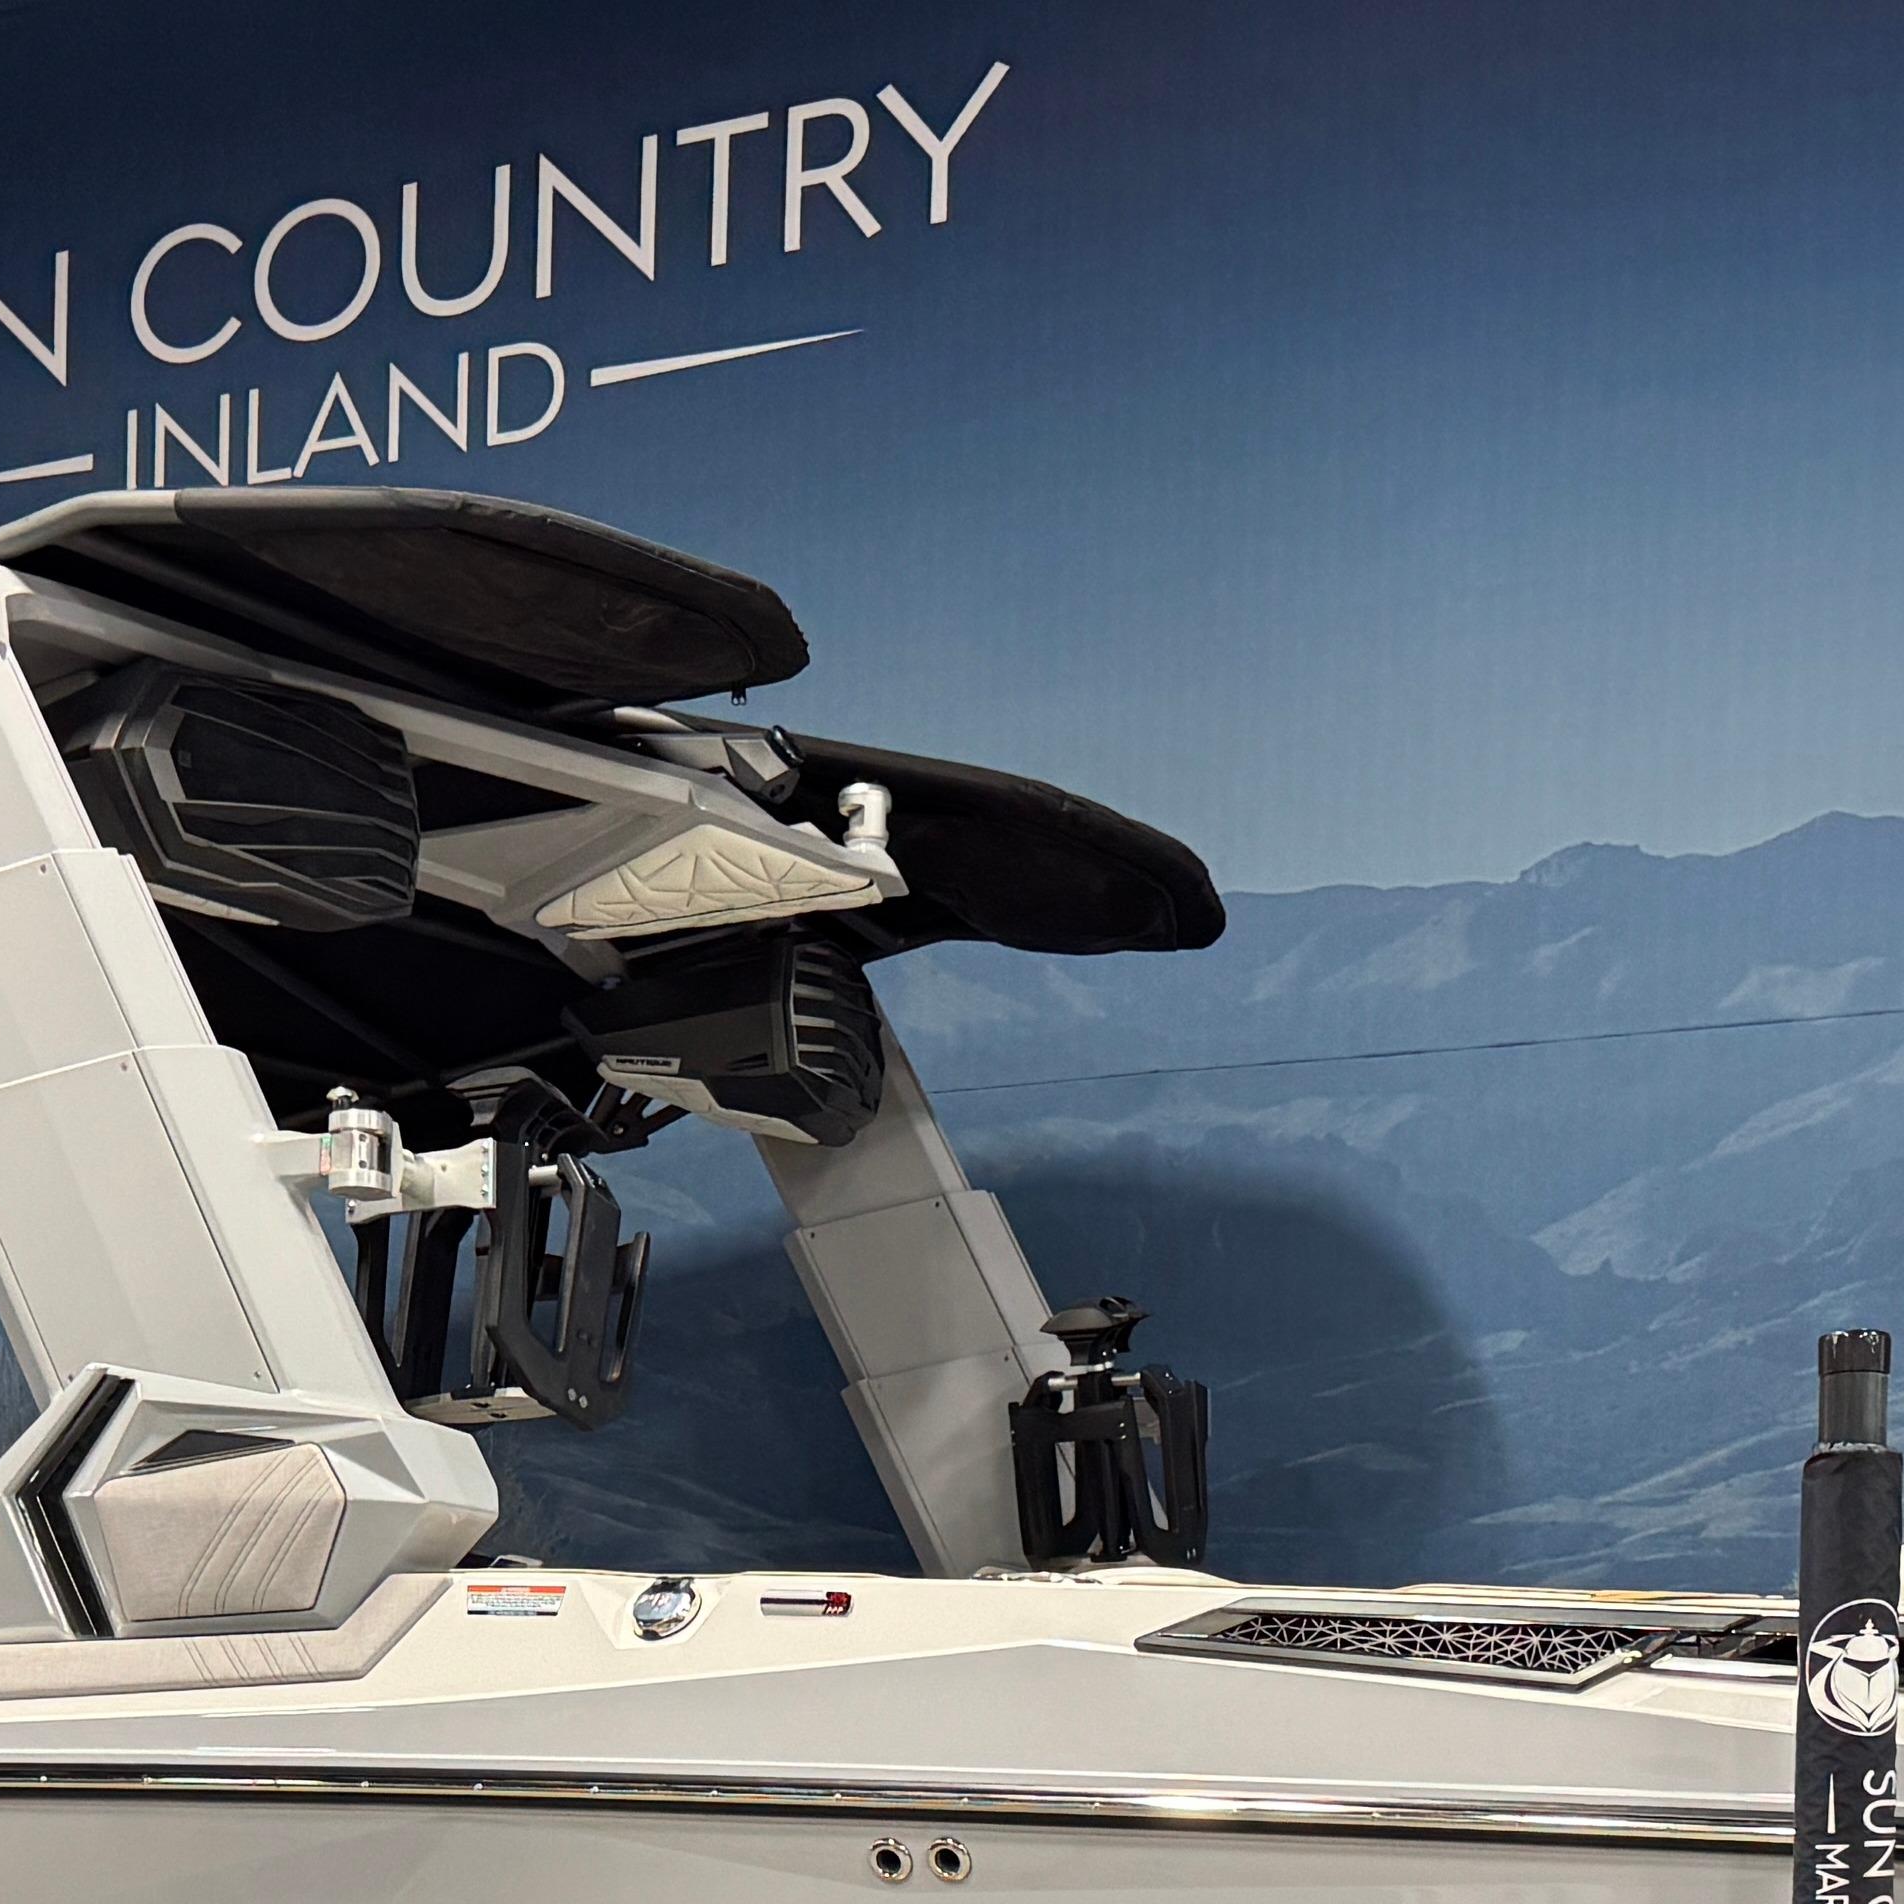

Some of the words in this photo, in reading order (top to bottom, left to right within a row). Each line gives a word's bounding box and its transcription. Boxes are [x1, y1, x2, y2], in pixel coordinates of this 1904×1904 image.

[129, 60, 1011, 366] COUNTRY
[125, 341, 567, 491] INLAND
[1862, 1768, 1897, 1880] SUN
